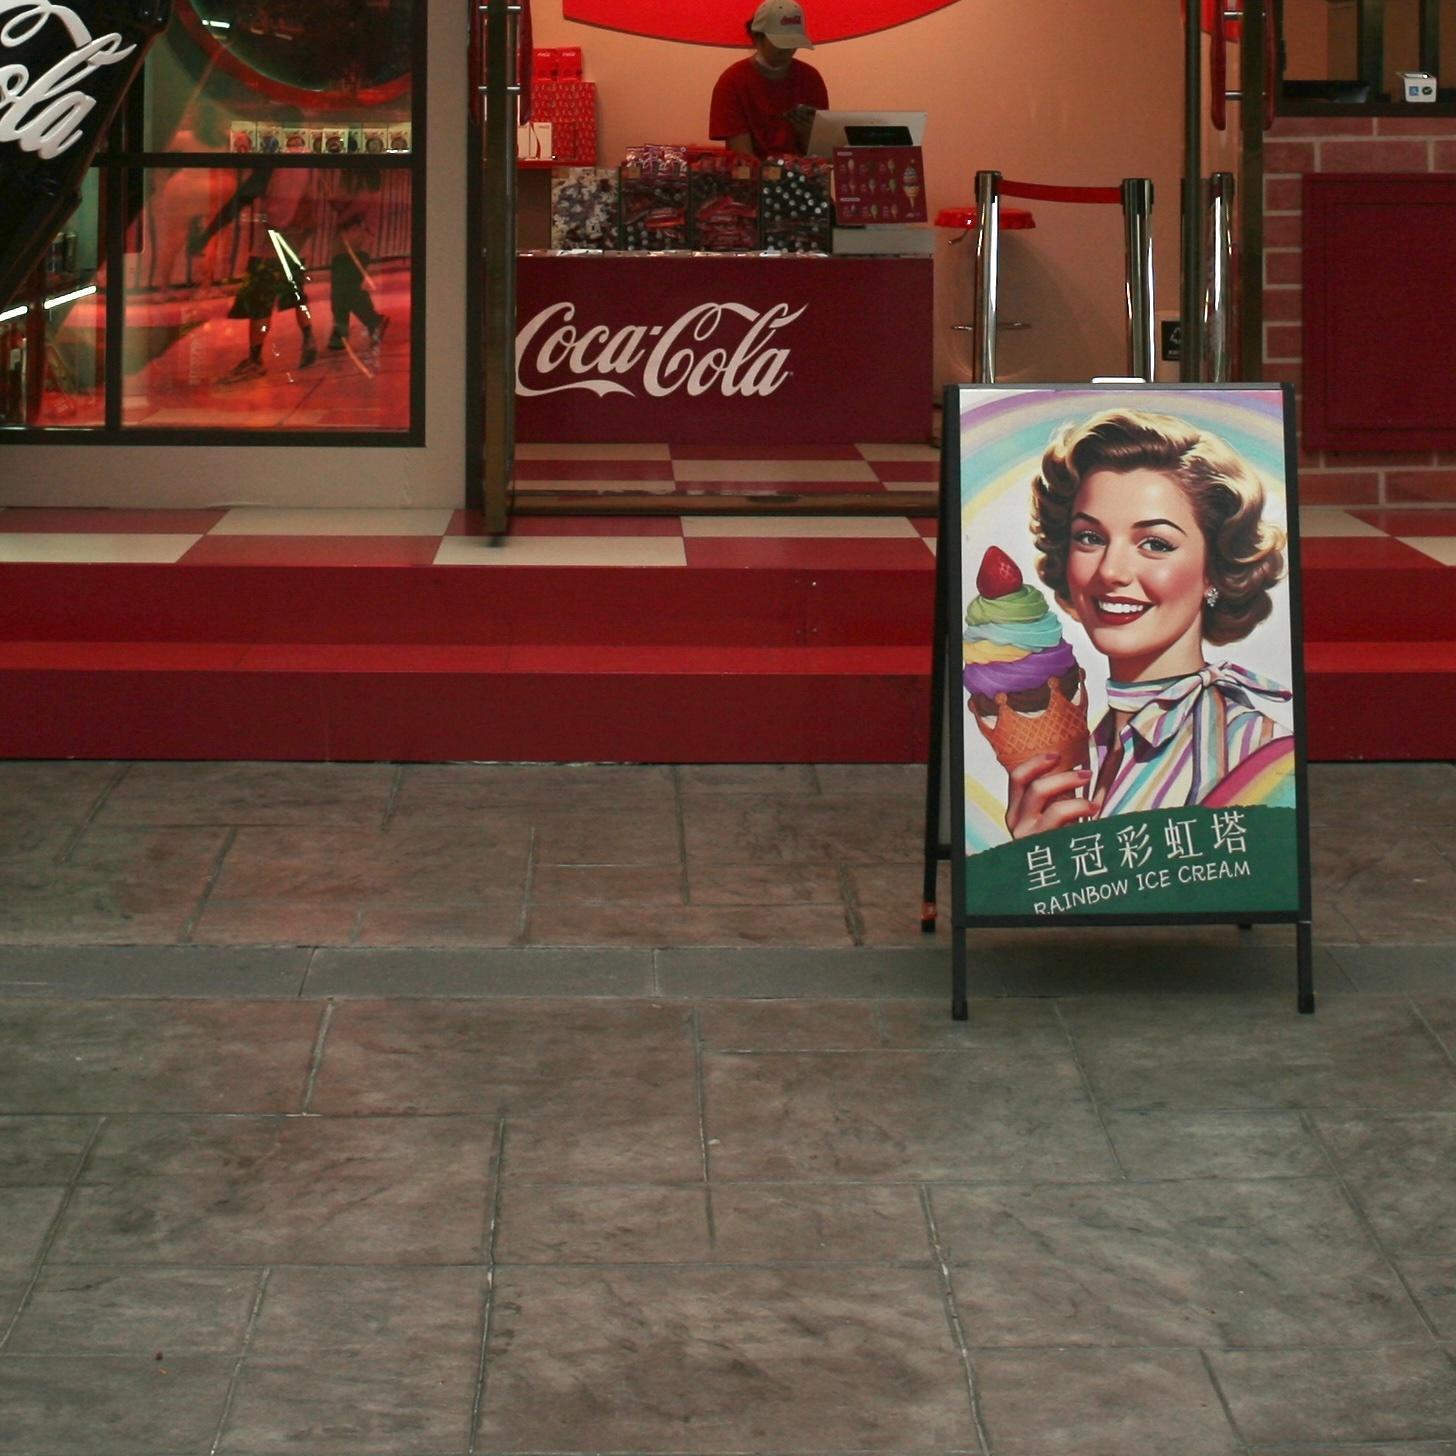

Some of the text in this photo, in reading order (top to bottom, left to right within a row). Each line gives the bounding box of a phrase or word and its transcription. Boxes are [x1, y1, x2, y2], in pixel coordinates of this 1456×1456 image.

[514, 301, 808, 398] Coca-Cola
[1026, 810, 1248, 891] 皇冠彩虹塔
[1033, 860, 1251, 915] RAINBOW ICE CREAM
